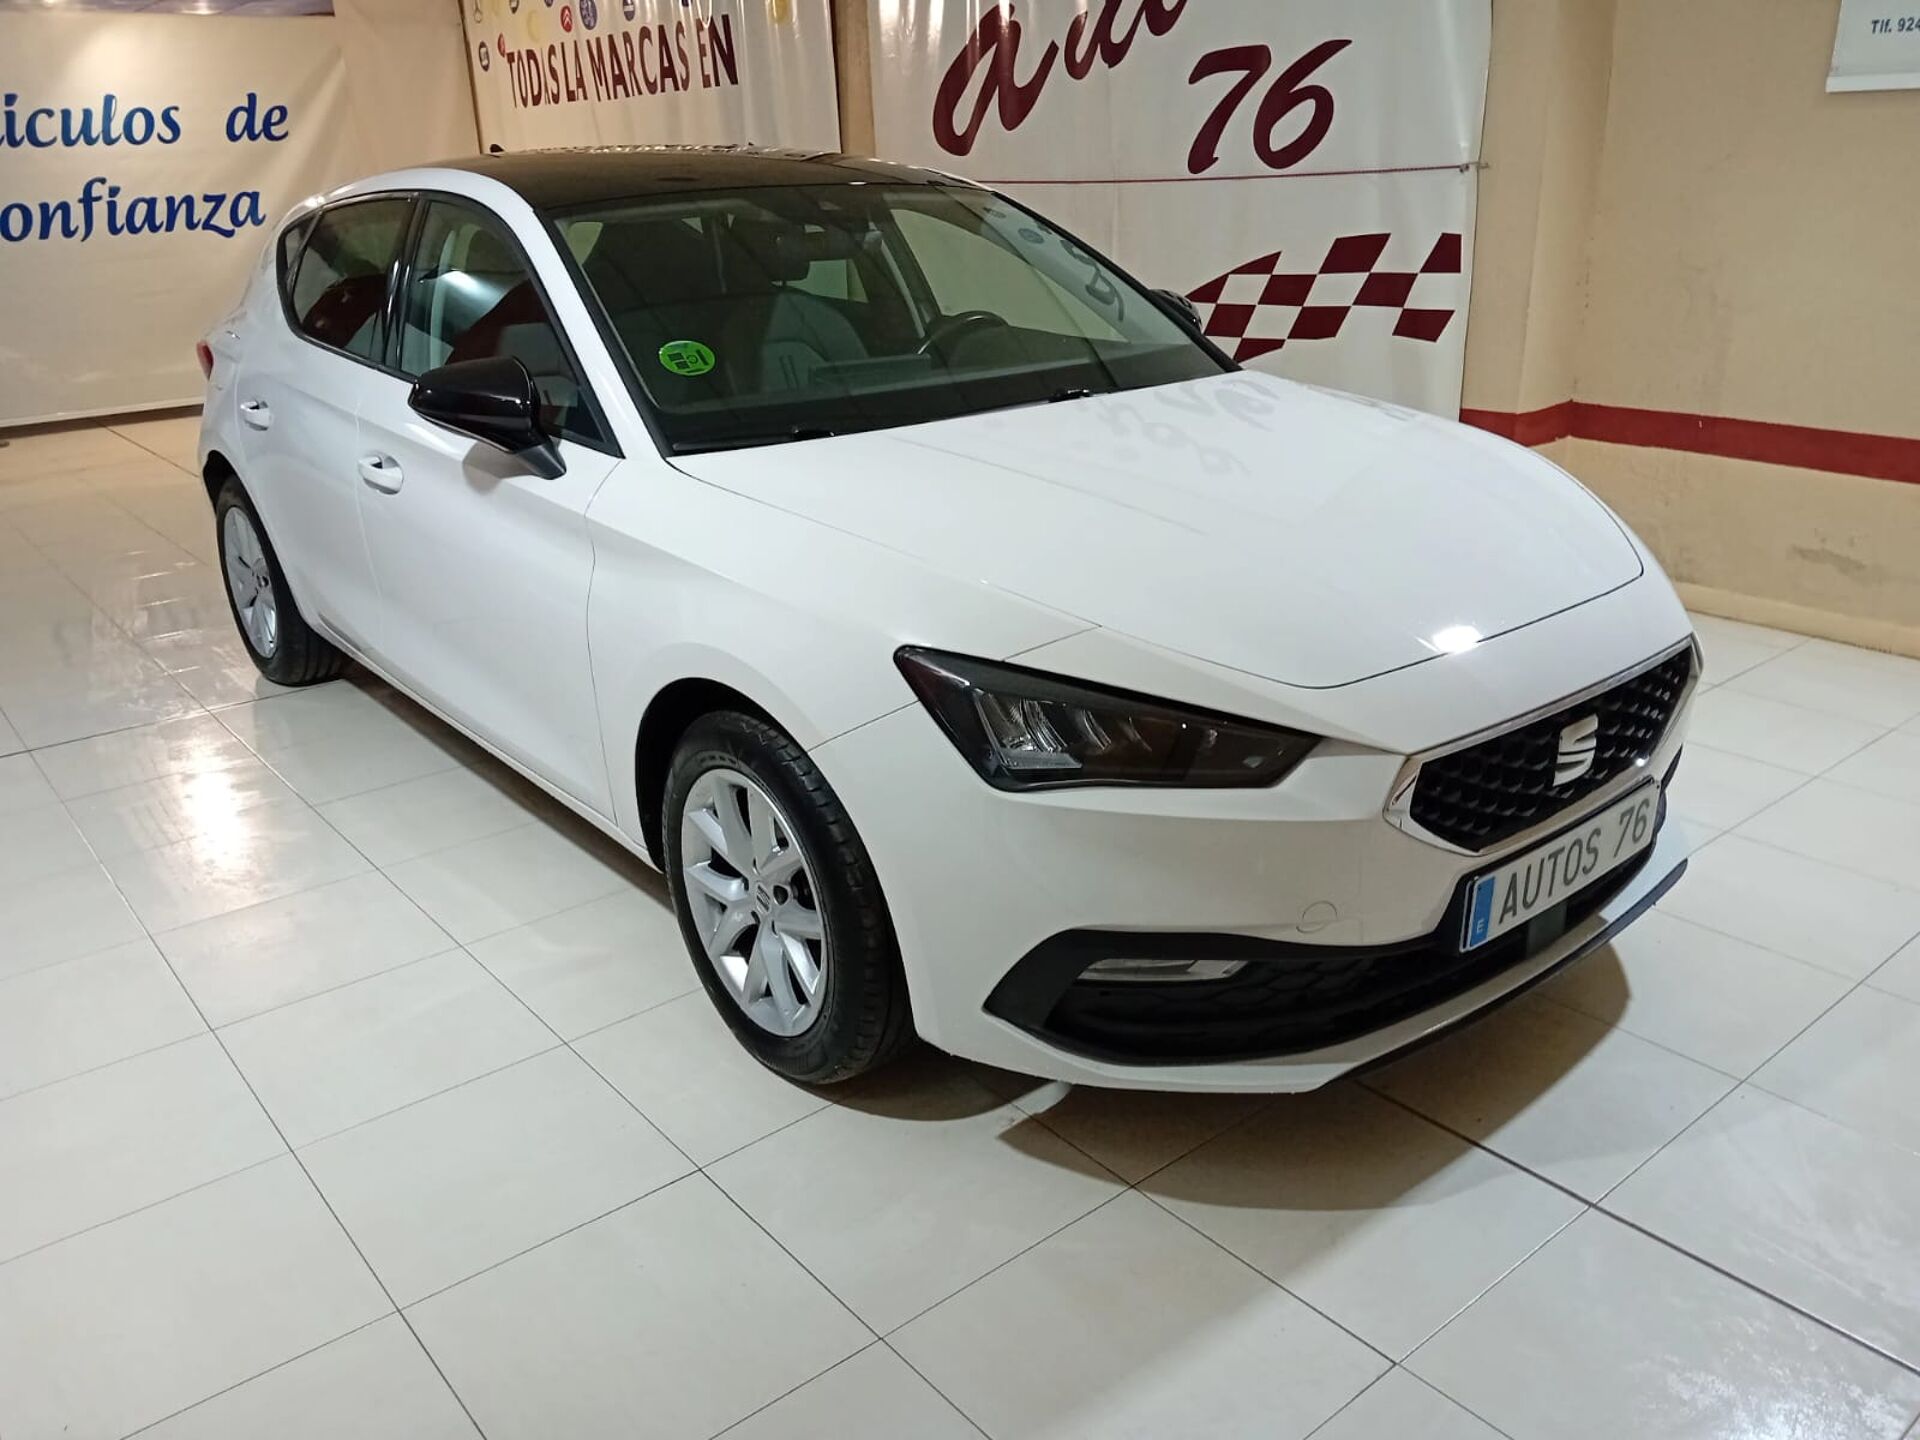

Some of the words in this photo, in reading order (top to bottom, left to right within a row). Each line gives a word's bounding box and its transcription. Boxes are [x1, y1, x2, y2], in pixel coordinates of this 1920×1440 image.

[586, 20, 690, 103] MARCAS
[696, 14, 739, 88] EN
[1187, 38, 1353, 175] 76
[0, 93, 181, 149] iculos
[225, 92, 289, 143] de
[1498, 827, 1602, 925] AUTOS
[1613, 798, 1650, 859] 76
